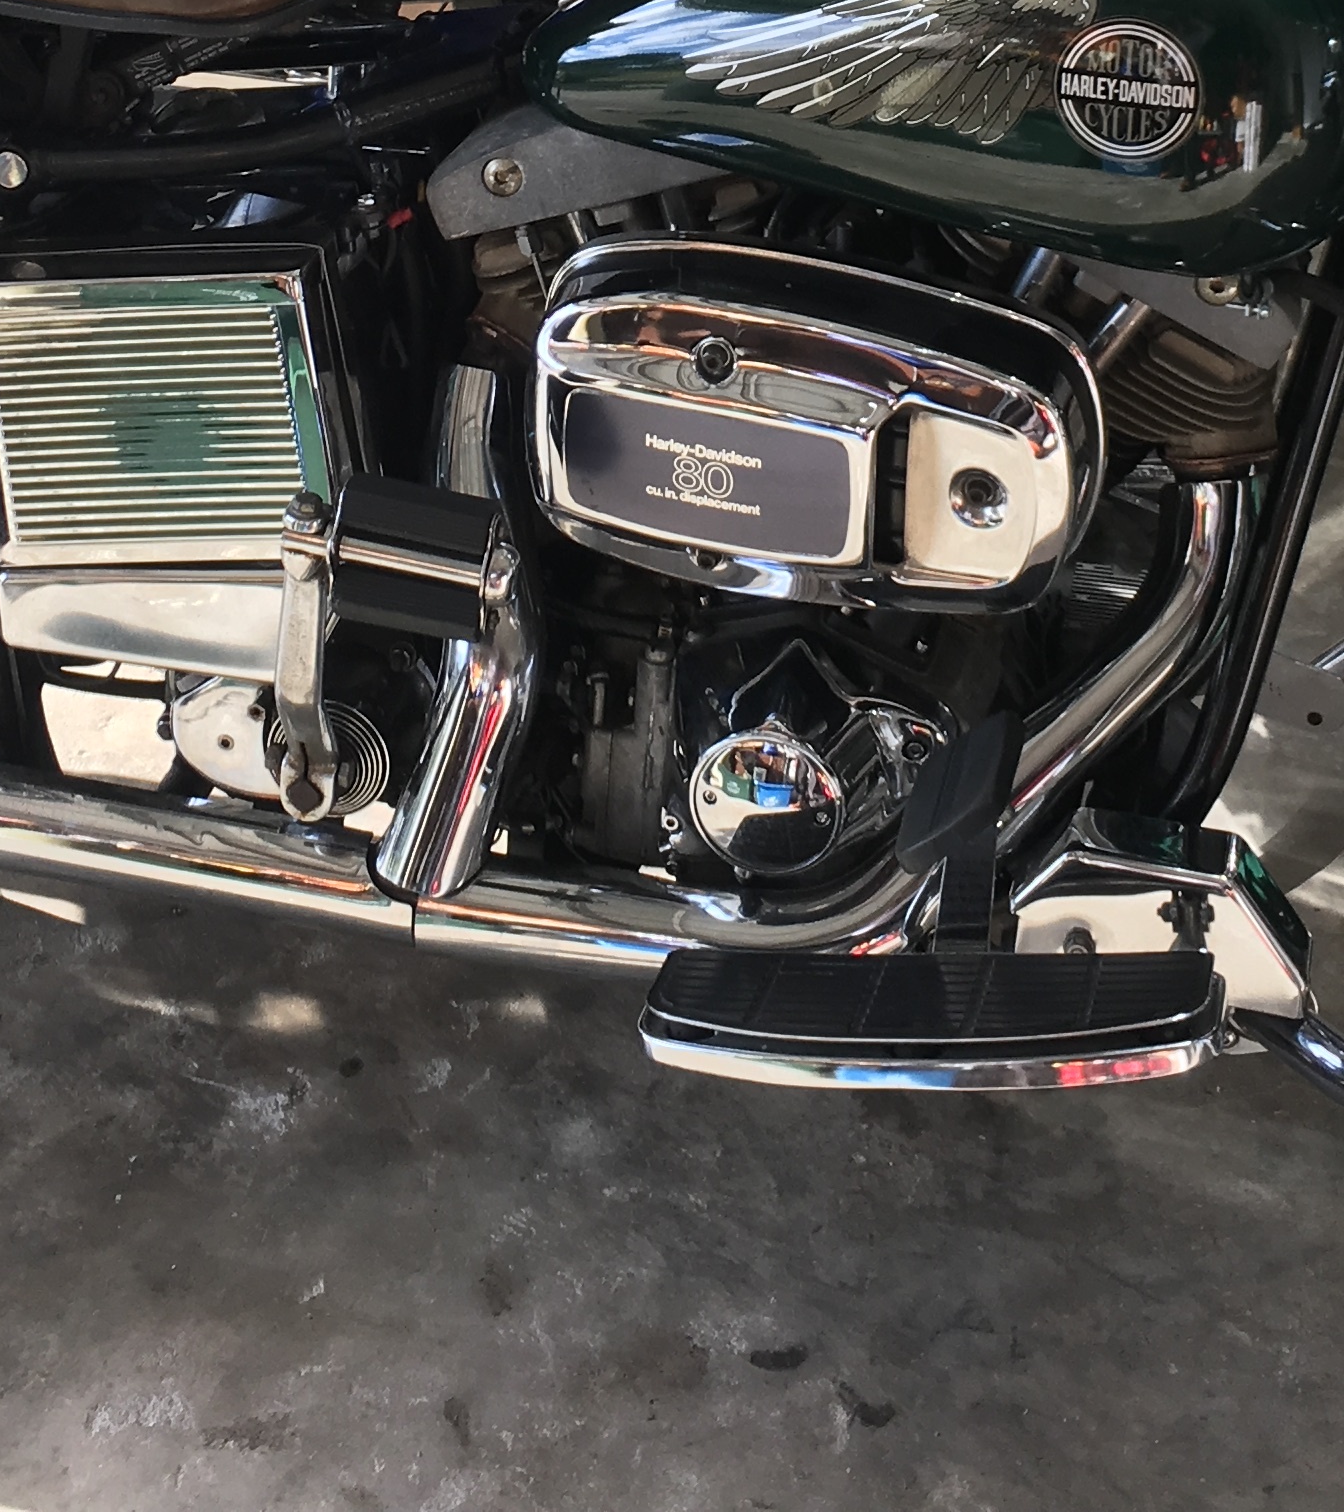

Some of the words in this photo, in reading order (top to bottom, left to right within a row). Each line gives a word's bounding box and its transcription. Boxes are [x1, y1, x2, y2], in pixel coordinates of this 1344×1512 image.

[1086, 39, 1174, 80] MOTOR
[1061, 72, 1195, 108] HARLEY-DAVIDSON
[1085, 103, 1170, 142] CYCLES
[645, 433, 762, 469] Harley-Davidson
[672, 454, 733, 499] 80
[645, 485, 663, 498] cu.
[664, 486, 678, 500] in.
[679, 490, 761, 516] displacement
